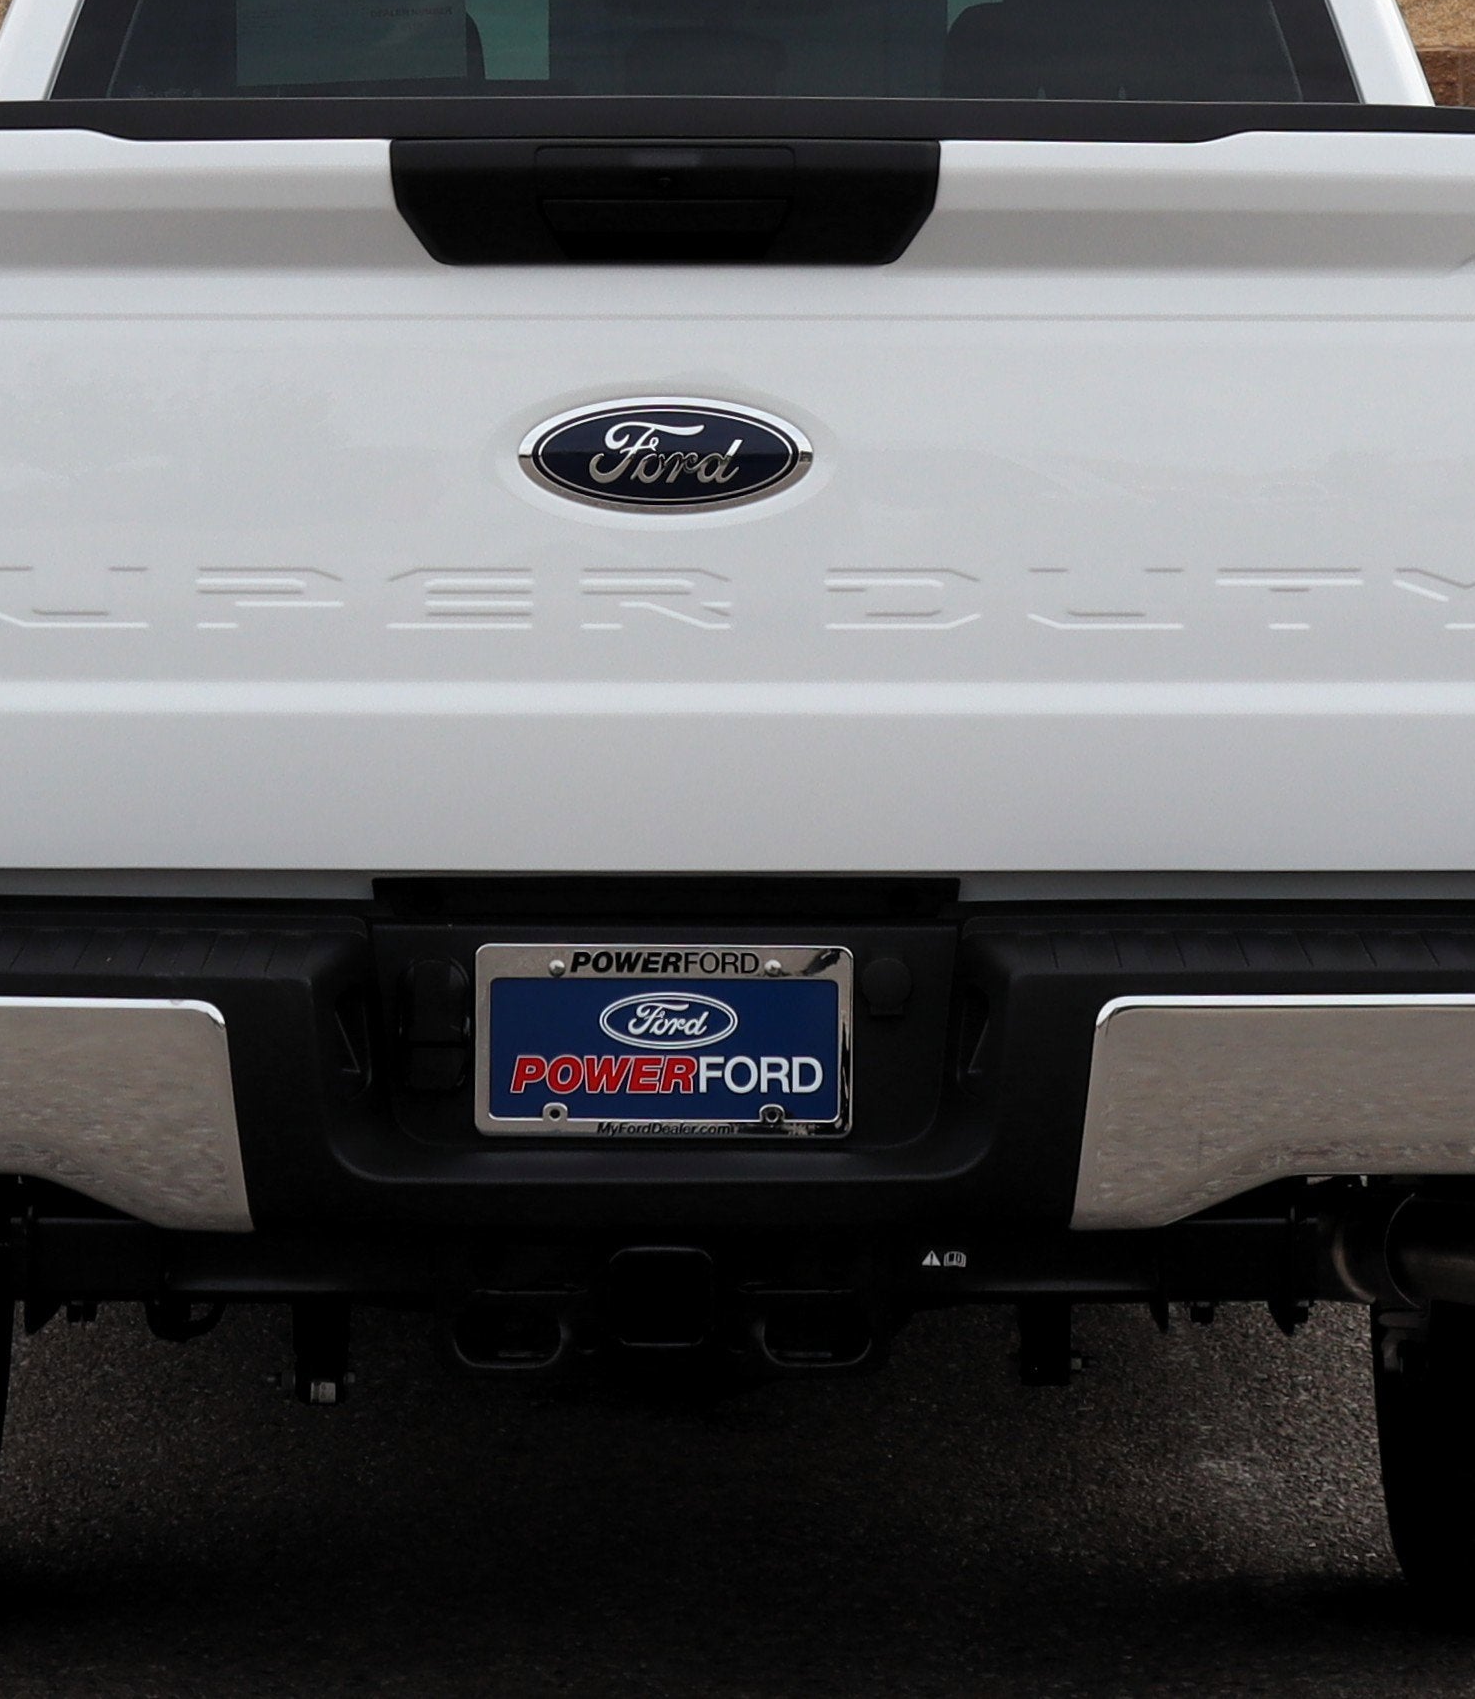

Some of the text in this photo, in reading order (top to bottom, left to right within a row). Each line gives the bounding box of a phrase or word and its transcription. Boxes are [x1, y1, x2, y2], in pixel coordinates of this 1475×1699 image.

[588, 420, 744, 484] Ford
[570, 951, 760, 974] POWERFORD
[627, 1002, 709, 1037] Ford
[510, 1055, 824, 1094] POWERFORD
[597, 1122, 732, 1137] MyFordDealer.com
